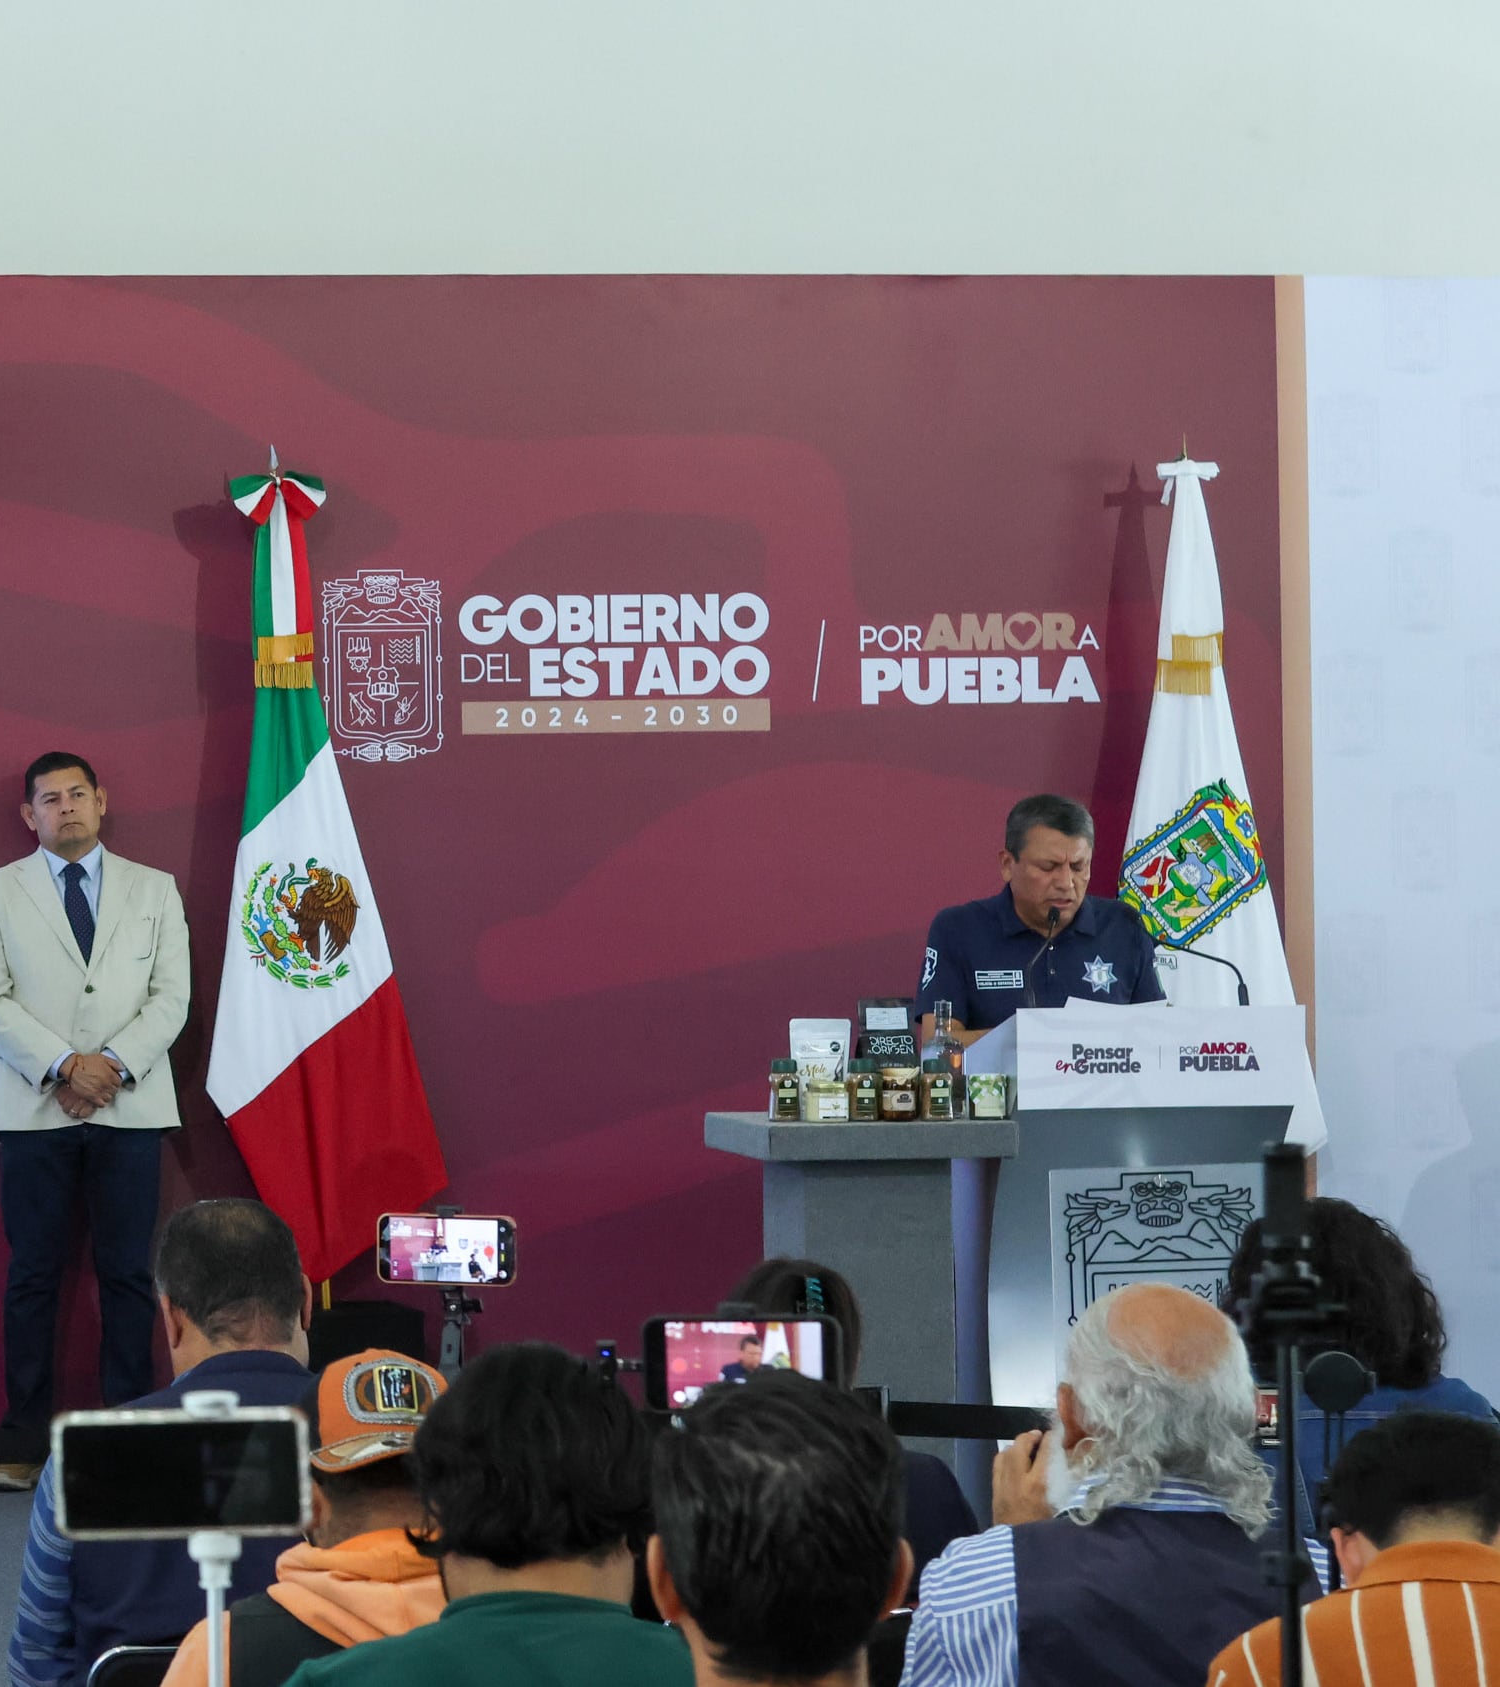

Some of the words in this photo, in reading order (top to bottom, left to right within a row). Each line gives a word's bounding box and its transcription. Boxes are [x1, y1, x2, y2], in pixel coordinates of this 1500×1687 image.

[458, 592, 770, 645] GOBIERNO
[859, 625, 922, 652] POR
[921, 612, 1077, 651] AMOR
[1076, 624, 1100, 650] A
[460, 653, 522, 683] DEL
[529, 645, 770, 697] ESTADO
[860, 656, 1101, 705] PUEBLA
[495, 707, 589, 728] 2024
[644, 705, 738, 726] 2030
[868, 1035, 914, 1046] DIRECTO
[1179, 1046, 1200, 1055] POR
[1198, 1042, 1247, 1055] AMOR
[1247, 1046, 1254, 1054] A
[871, 1045, 914, 1055] ORIGEN
[1072, 1043, 1134, 1060] Pensar
[1055, 1059, 1080, 1074] en
[1075, 1058, 1142, 1075] Grande
[1179, 1055, 1260, 1072] PUEBLA
